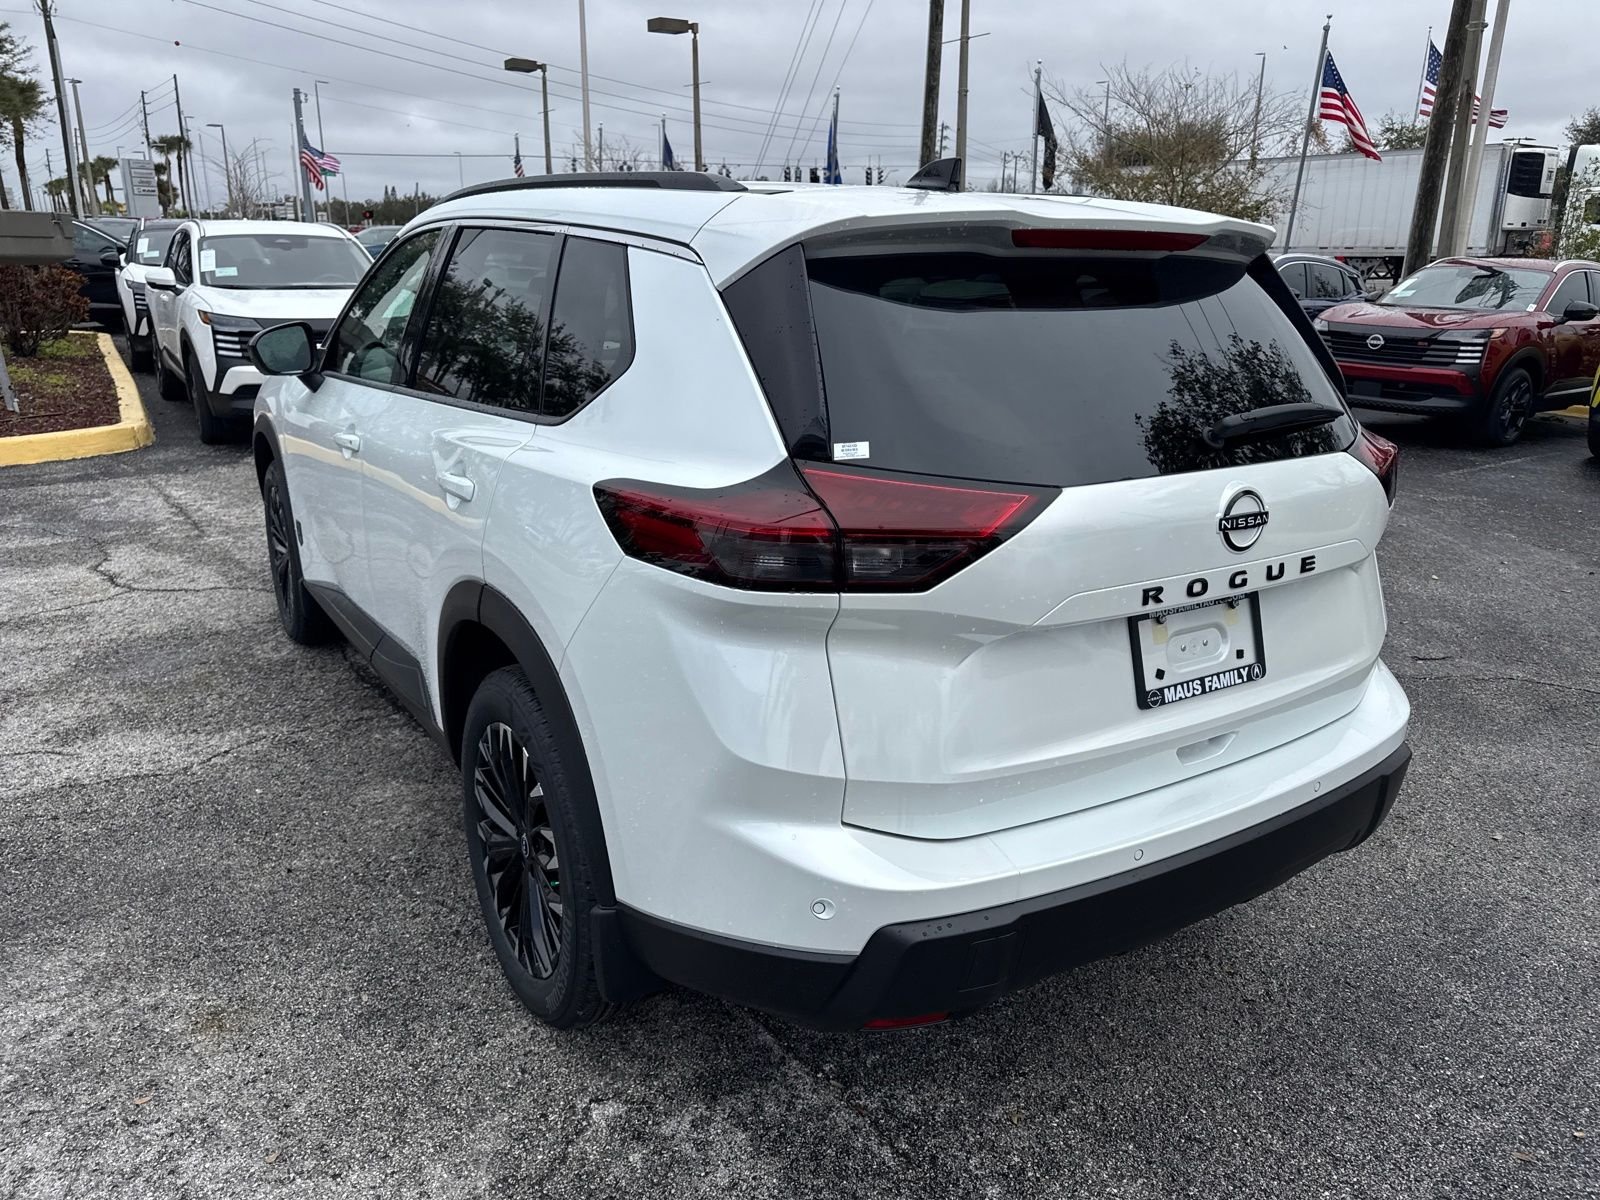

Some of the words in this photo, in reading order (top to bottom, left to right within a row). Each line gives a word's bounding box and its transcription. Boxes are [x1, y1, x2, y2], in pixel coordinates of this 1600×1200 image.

[1221, 514, 1268, 529] NISSAN
[1141, 554, 1316, 606] ROGUE
[1163, 679, 1203, 703] MAUS
[1204, 666, 1249, 692] FAMILY
